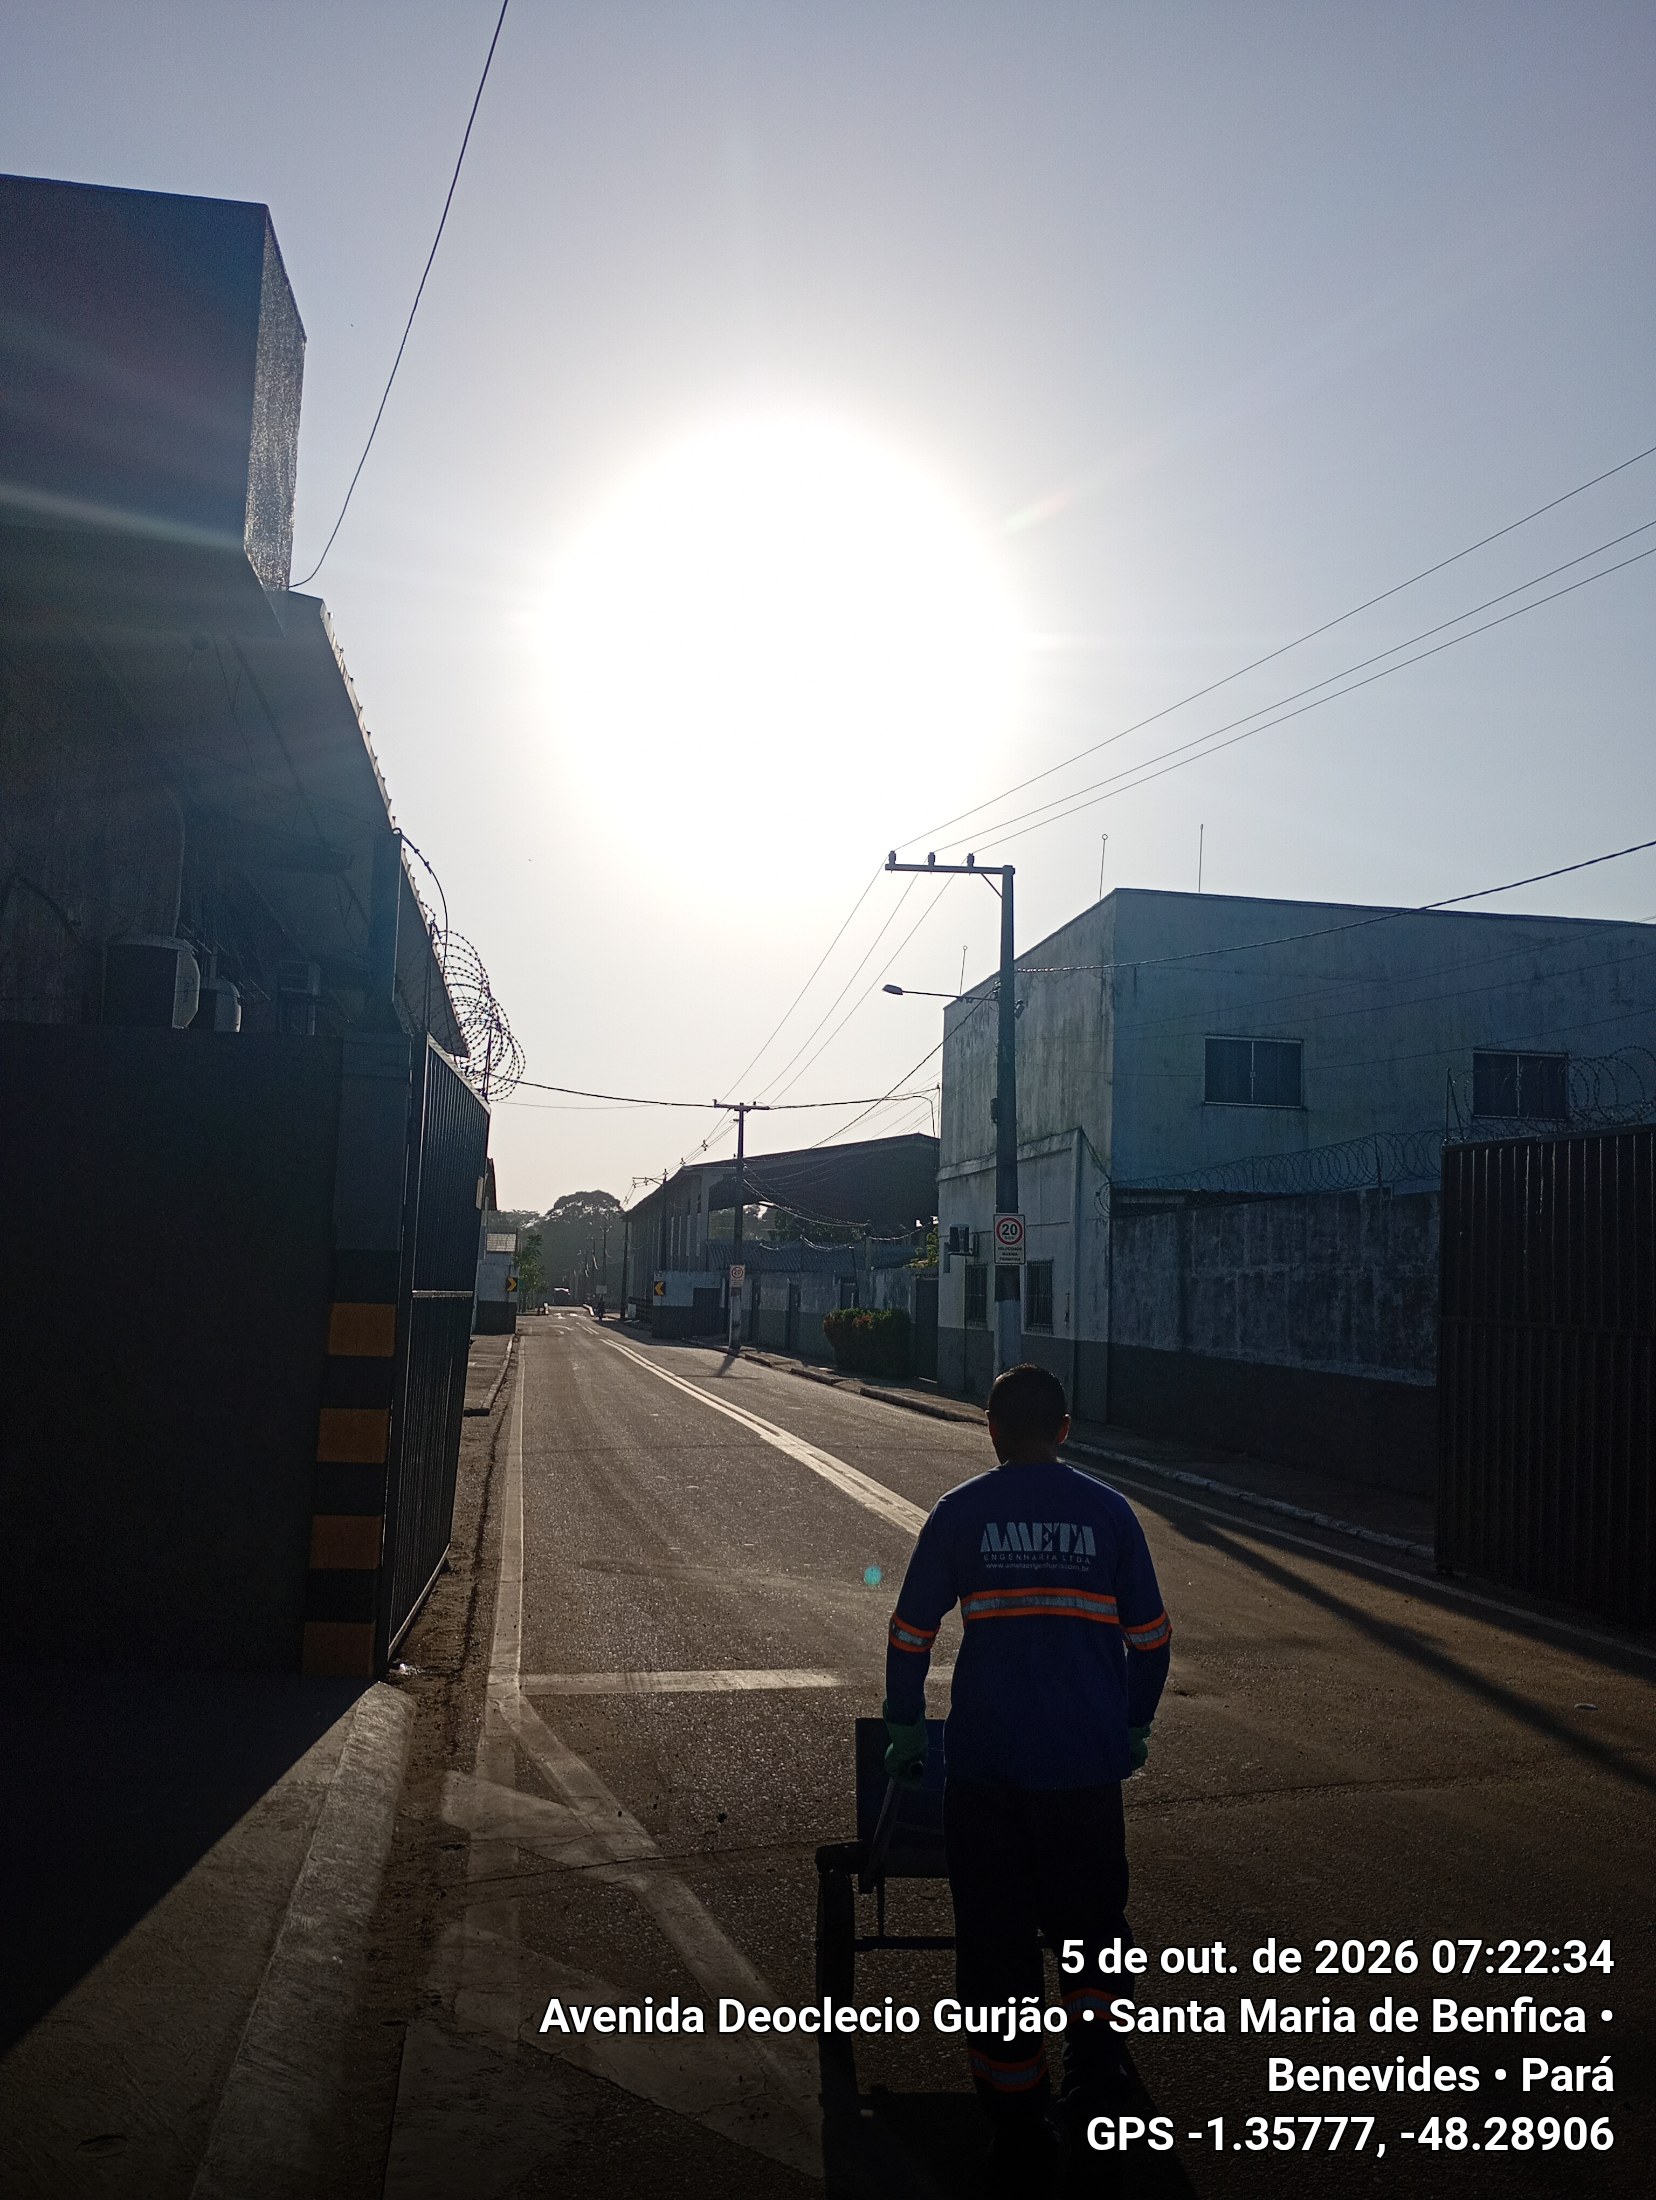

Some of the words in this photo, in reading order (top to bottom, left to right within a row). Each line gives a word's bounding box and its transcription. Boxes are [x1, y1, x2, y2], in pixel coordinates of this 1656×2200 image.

[1002, 1224, 1017, 1235] 20
[980, 1522, 1096, 1557] AMETA
[983, 1553, 1057, 1561] ENGENHARIA
[1062, 1555, 1091, 1564] LTDA
